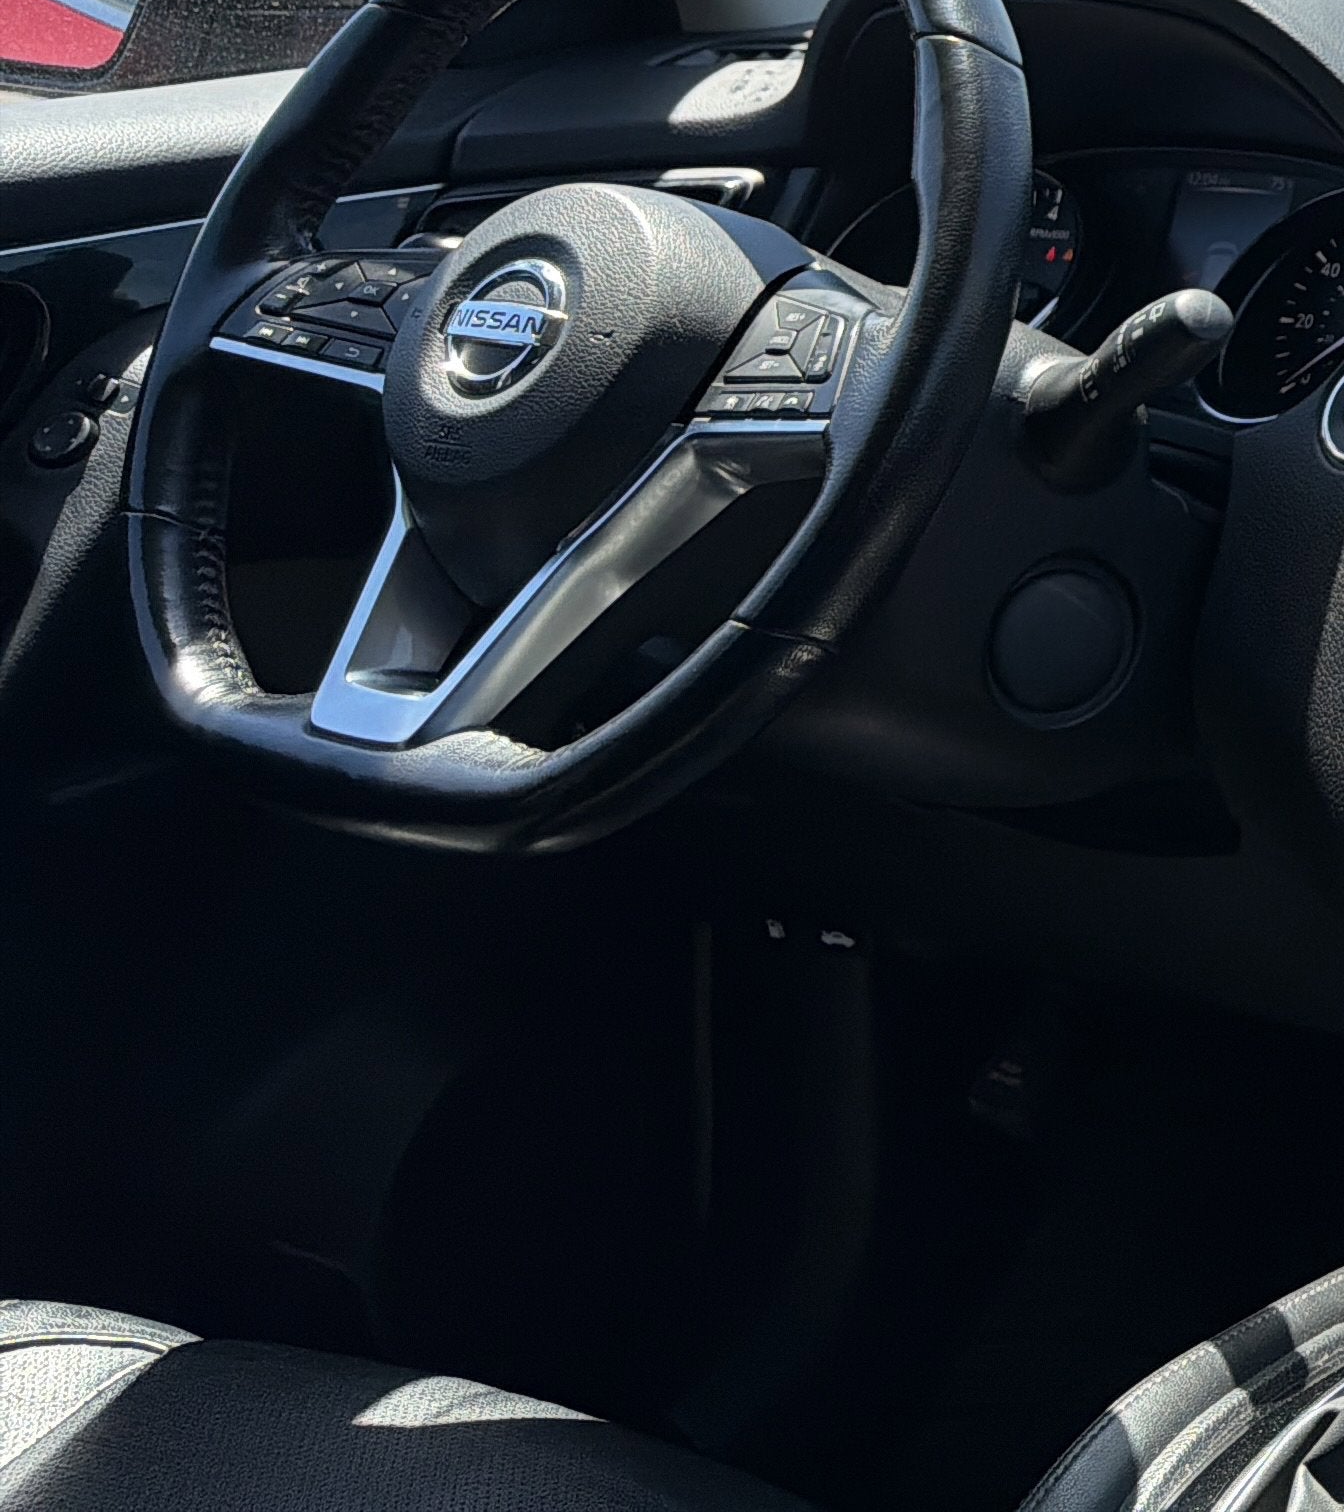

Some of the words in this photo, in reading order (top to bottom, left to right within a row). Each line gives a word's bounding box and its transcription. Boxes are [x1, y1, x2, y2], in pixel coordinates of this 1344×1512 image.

[1321, 262, 1341, 278] 40
[452, 309, 544, 335] NISSAN
[1295, 314, 1314, 329] 20
